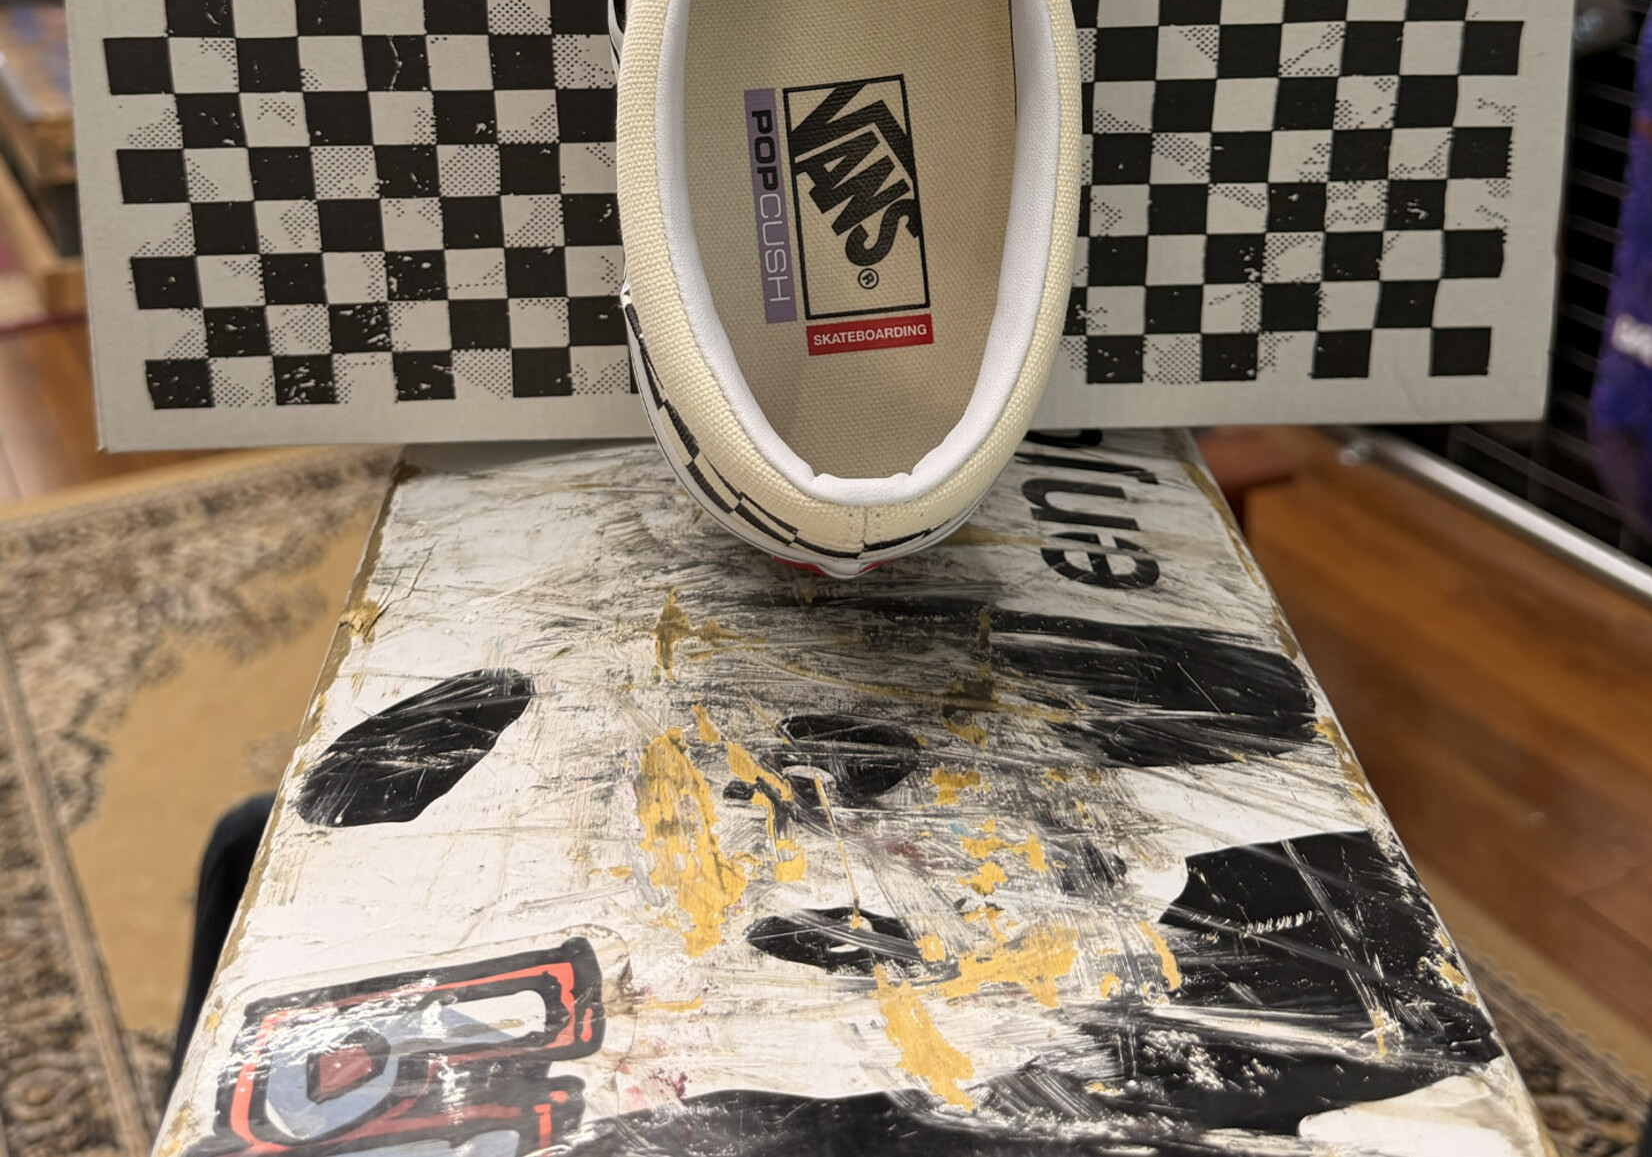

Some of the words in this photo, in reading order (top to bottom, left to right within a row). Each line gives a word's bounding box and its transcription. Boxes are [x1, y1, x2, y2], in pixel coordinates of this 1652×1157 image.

[751, 109, 791, 303] POPCUSH
[789, 83, 921, 267] VANS
[813, 324, 928, 347] SKATEBOARDING
